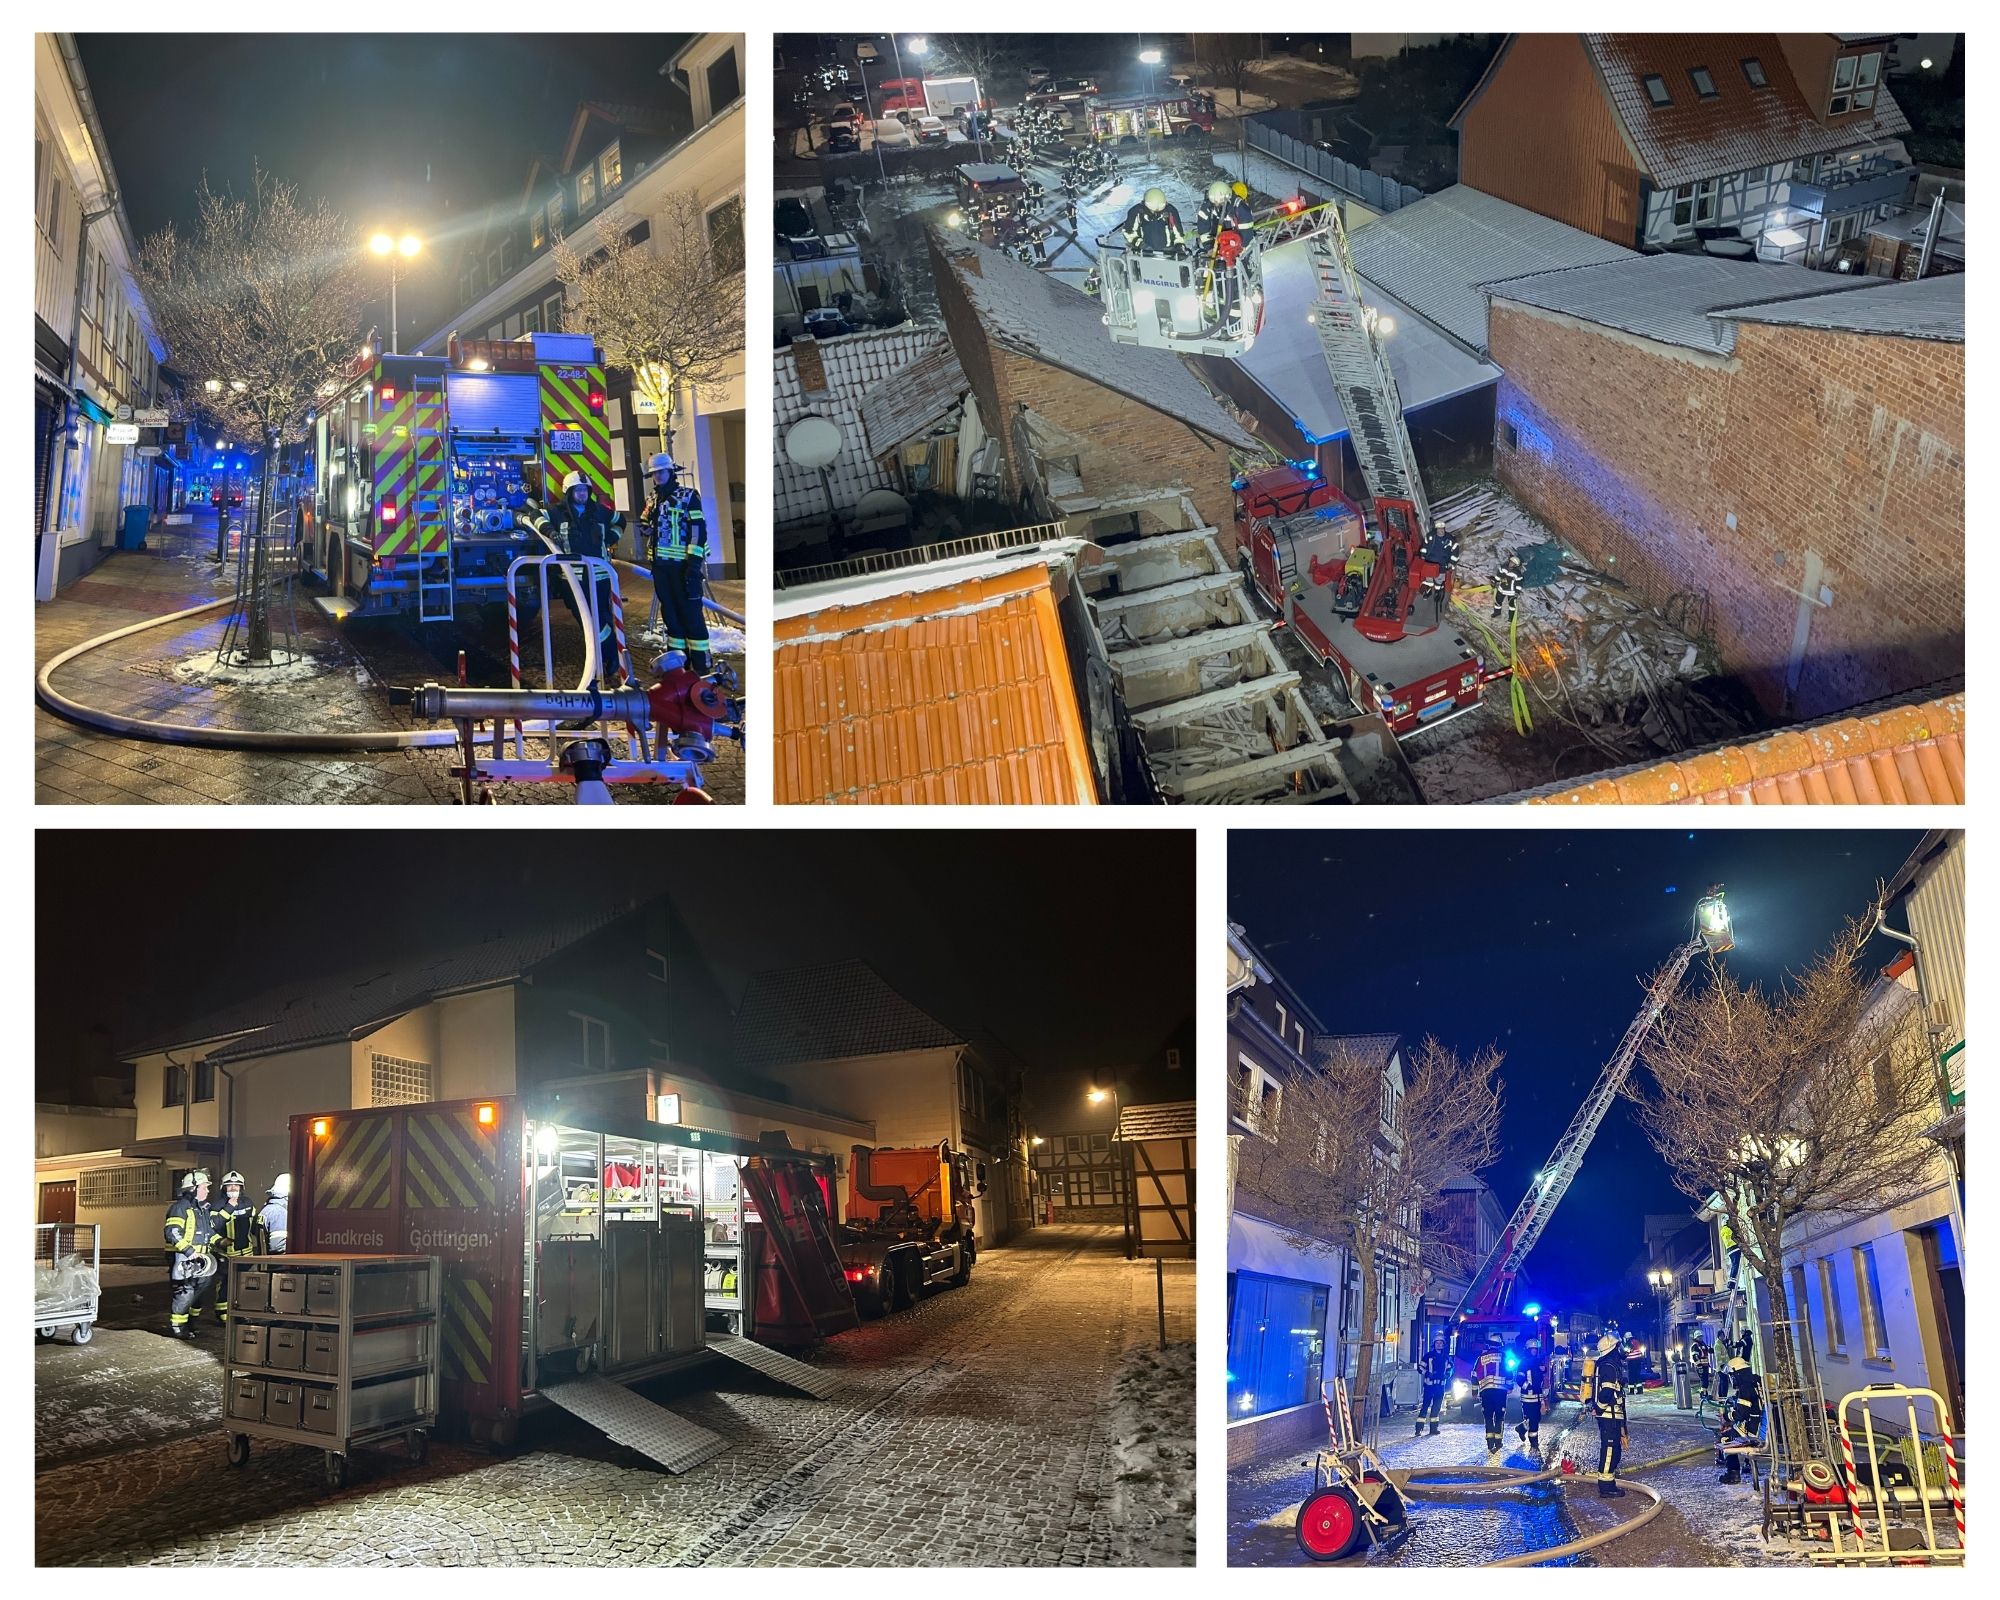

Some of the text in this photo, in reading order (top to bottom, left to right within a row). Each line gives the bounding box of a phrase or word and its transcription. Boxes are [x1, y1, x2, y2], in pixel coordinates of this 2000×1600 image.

[1143, 278, 1180, 289] MAGIRUS
[557, 369, 588, 379] 22-48-1
[560, 432, 576, 441] OHA
[553, 441, 559, 449] F
[316, 1228, 489, 1251] Landkreis Göttingen
